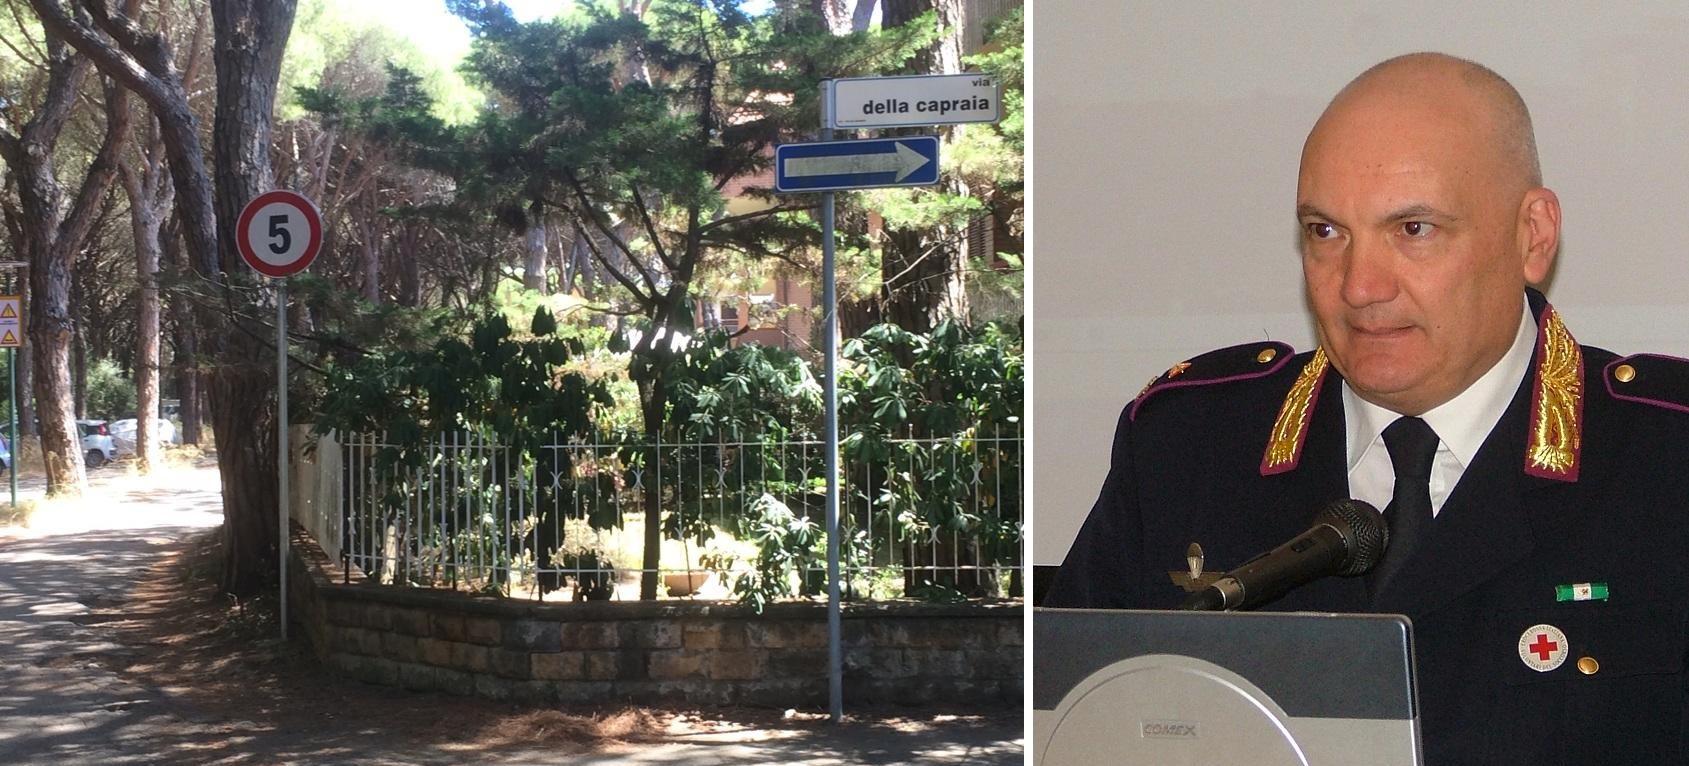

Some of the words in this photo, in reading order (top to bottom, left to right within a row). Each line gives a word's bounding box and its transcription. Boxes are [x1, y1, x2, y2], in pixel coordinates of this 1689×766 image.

[972, 78, 990, 87] via
[863, 99, 909, 115] della
[916, 96, 989, 115] capraia
[268, 215, 291, 254] 5
